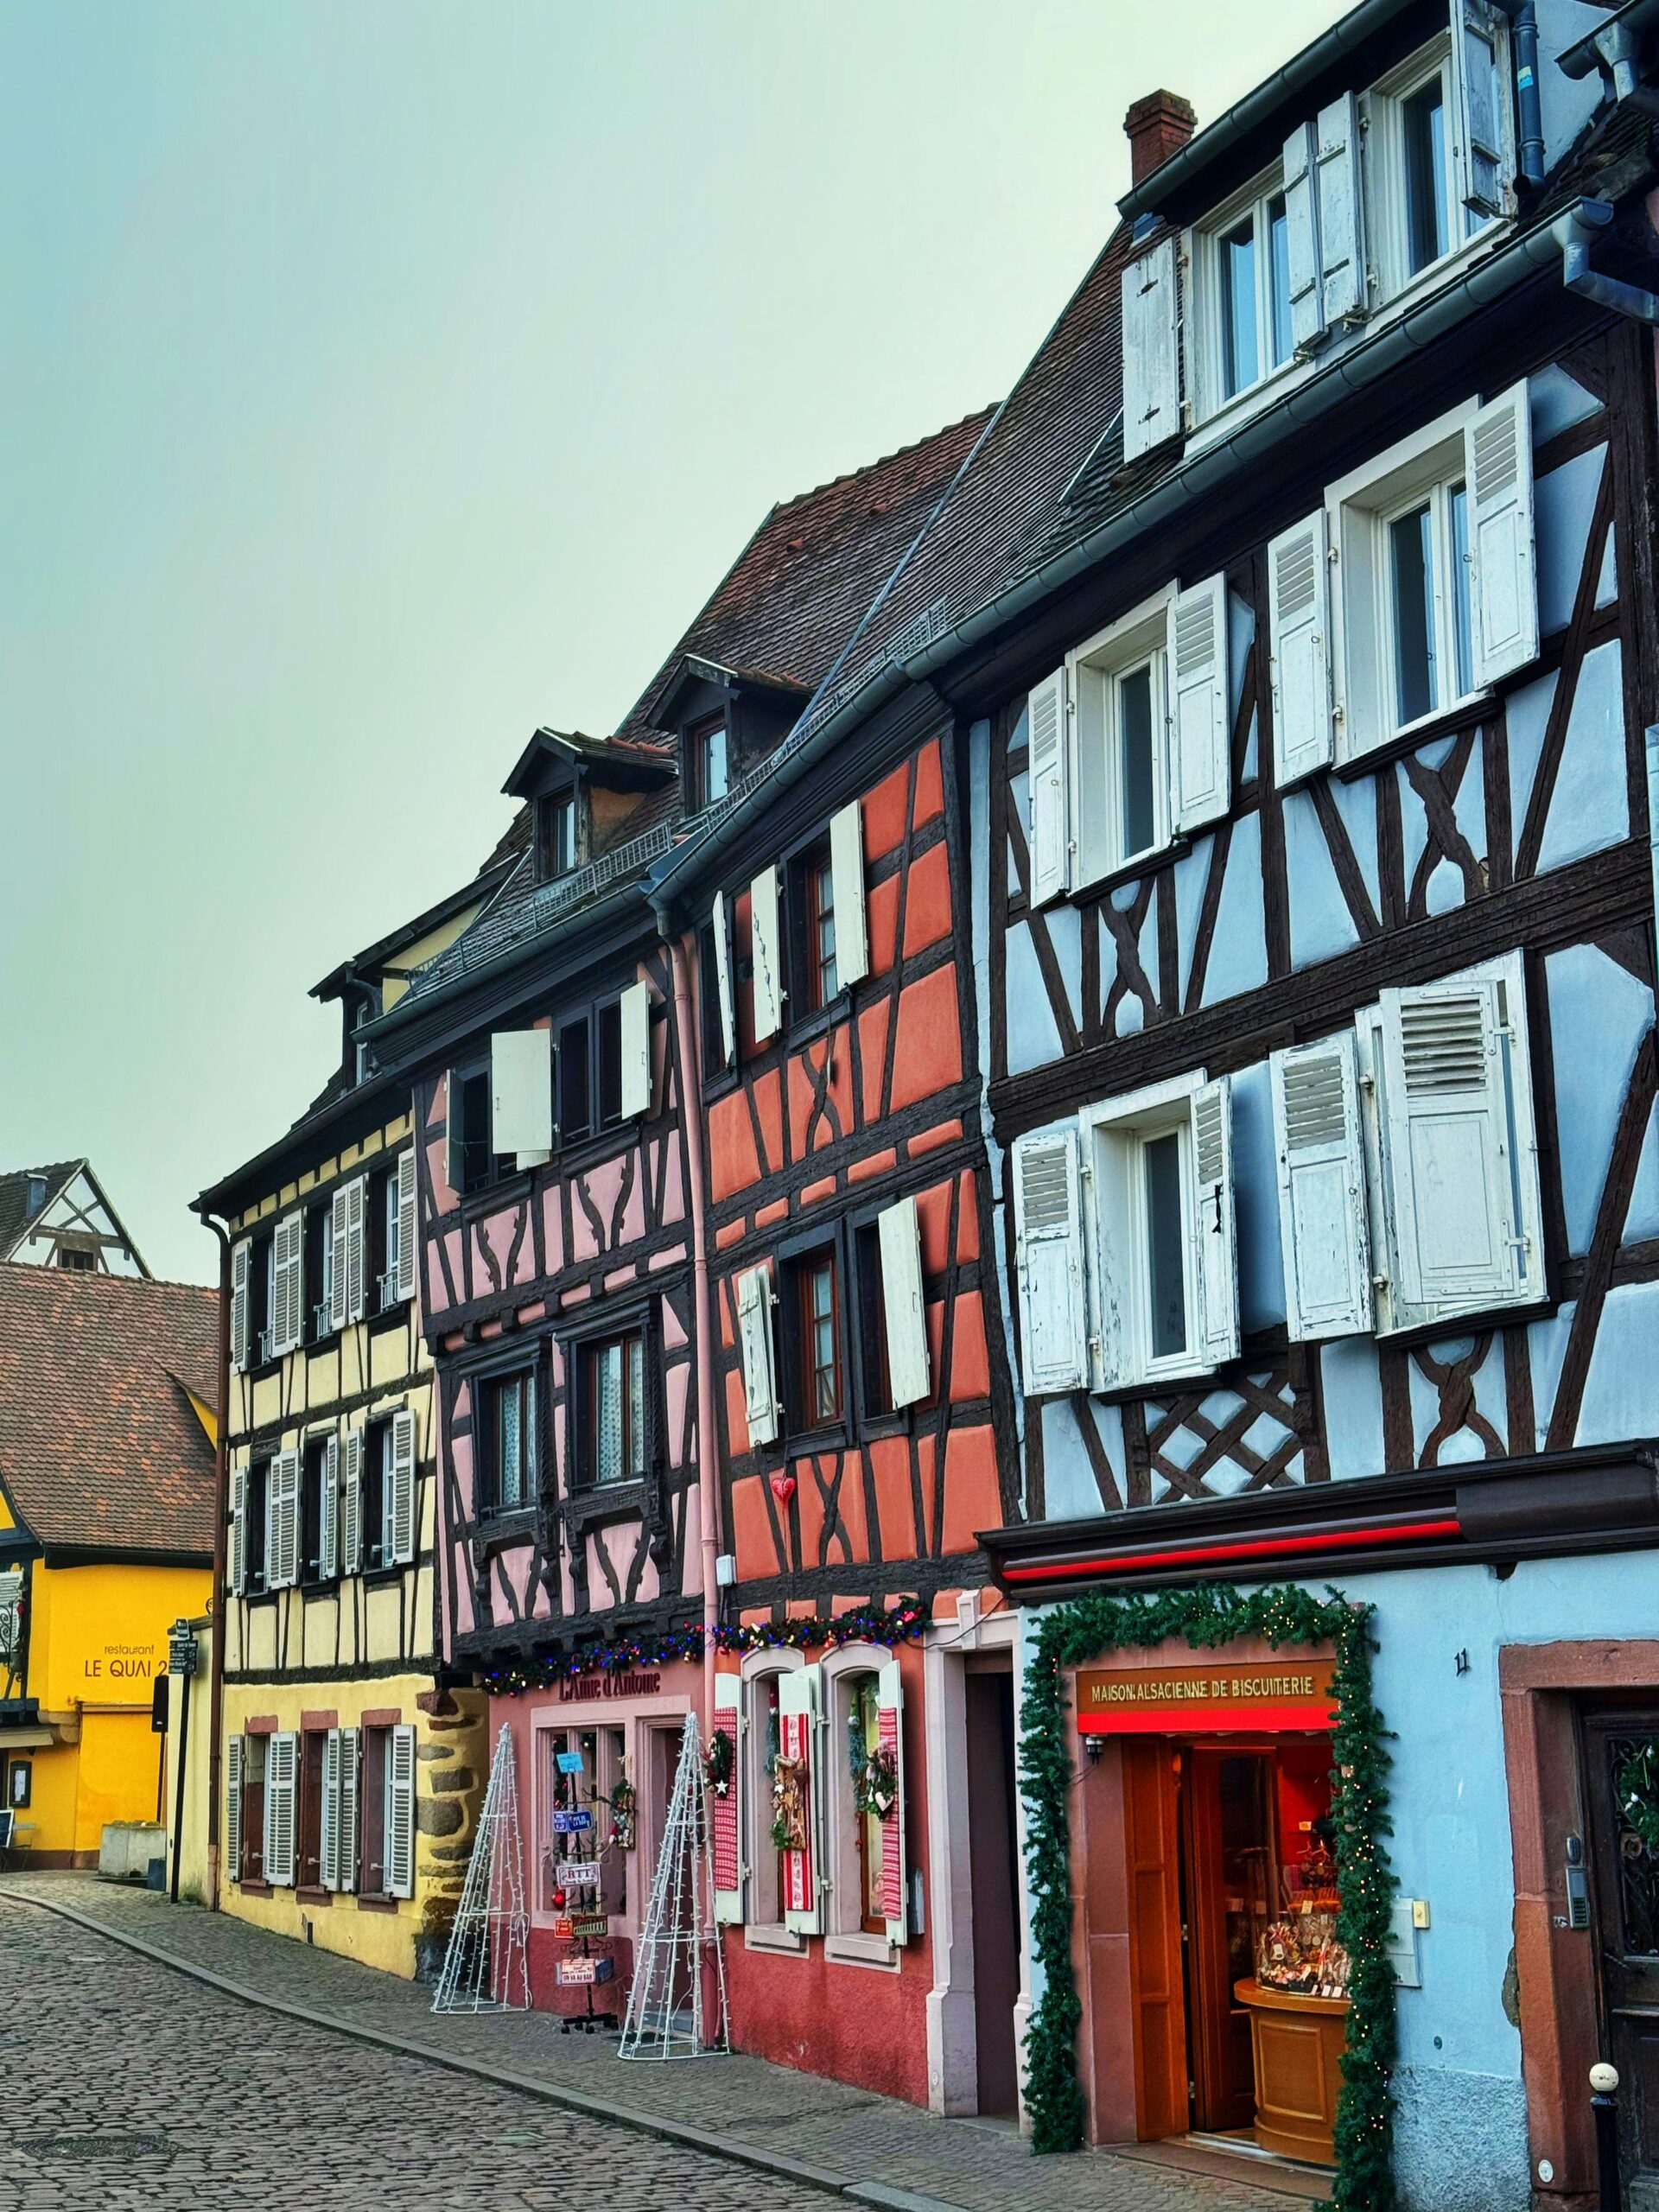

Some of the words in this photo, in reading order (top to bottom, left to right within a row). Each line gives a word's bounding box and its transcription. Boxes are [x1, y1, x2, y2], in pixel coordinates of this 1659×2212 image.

[105, 1643, 154, 1655] restaurant
[85, 1660, 101, 1677] LE
[110, 1660, 150, 1677] QUAI
[602, 1668, 660, 1697] d'Antoine
[1091, 1684, 1134, 1702] MAISON
[1137, 1681, 1207, 1700] ALSACIENNE
[1211, 1680, 1228, 1698] DE
[1231, 1676, 1313, 1697] BISCUITERIE
[568, 1869, 591, 1879] RTT
